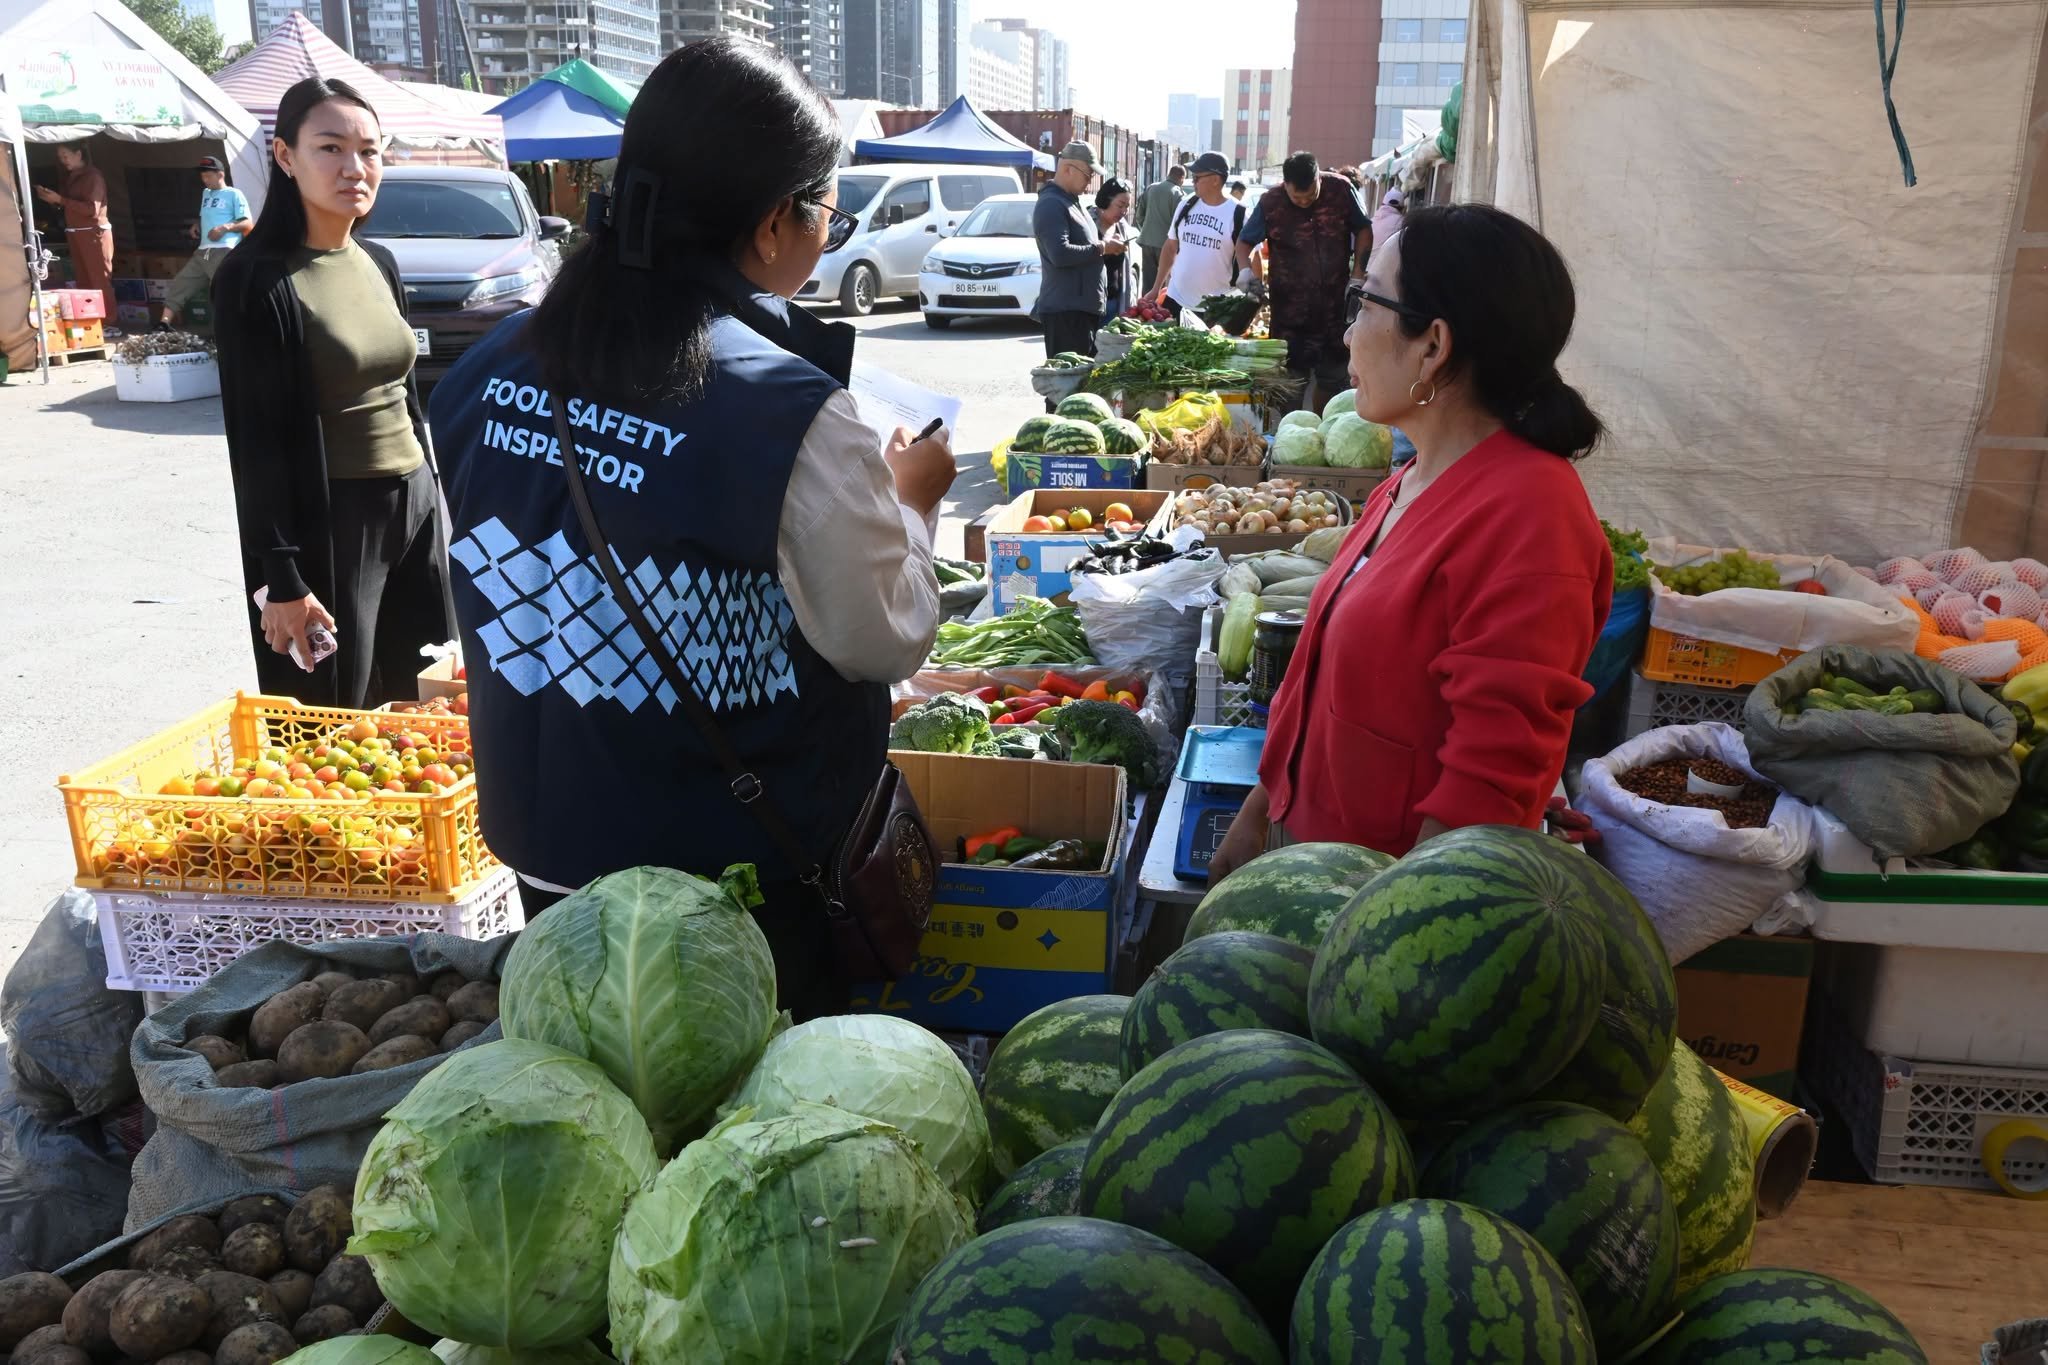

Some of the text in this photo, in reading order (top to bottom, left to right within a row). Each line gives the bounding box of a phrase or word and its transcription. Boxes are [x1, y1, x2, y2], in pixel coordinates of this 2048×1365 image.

[1182, 231, 1222, 250] ATHLETIC
[567, 397, 688, 457] SAFETY
[1050, 472, 1087, 487] MI SOLE
